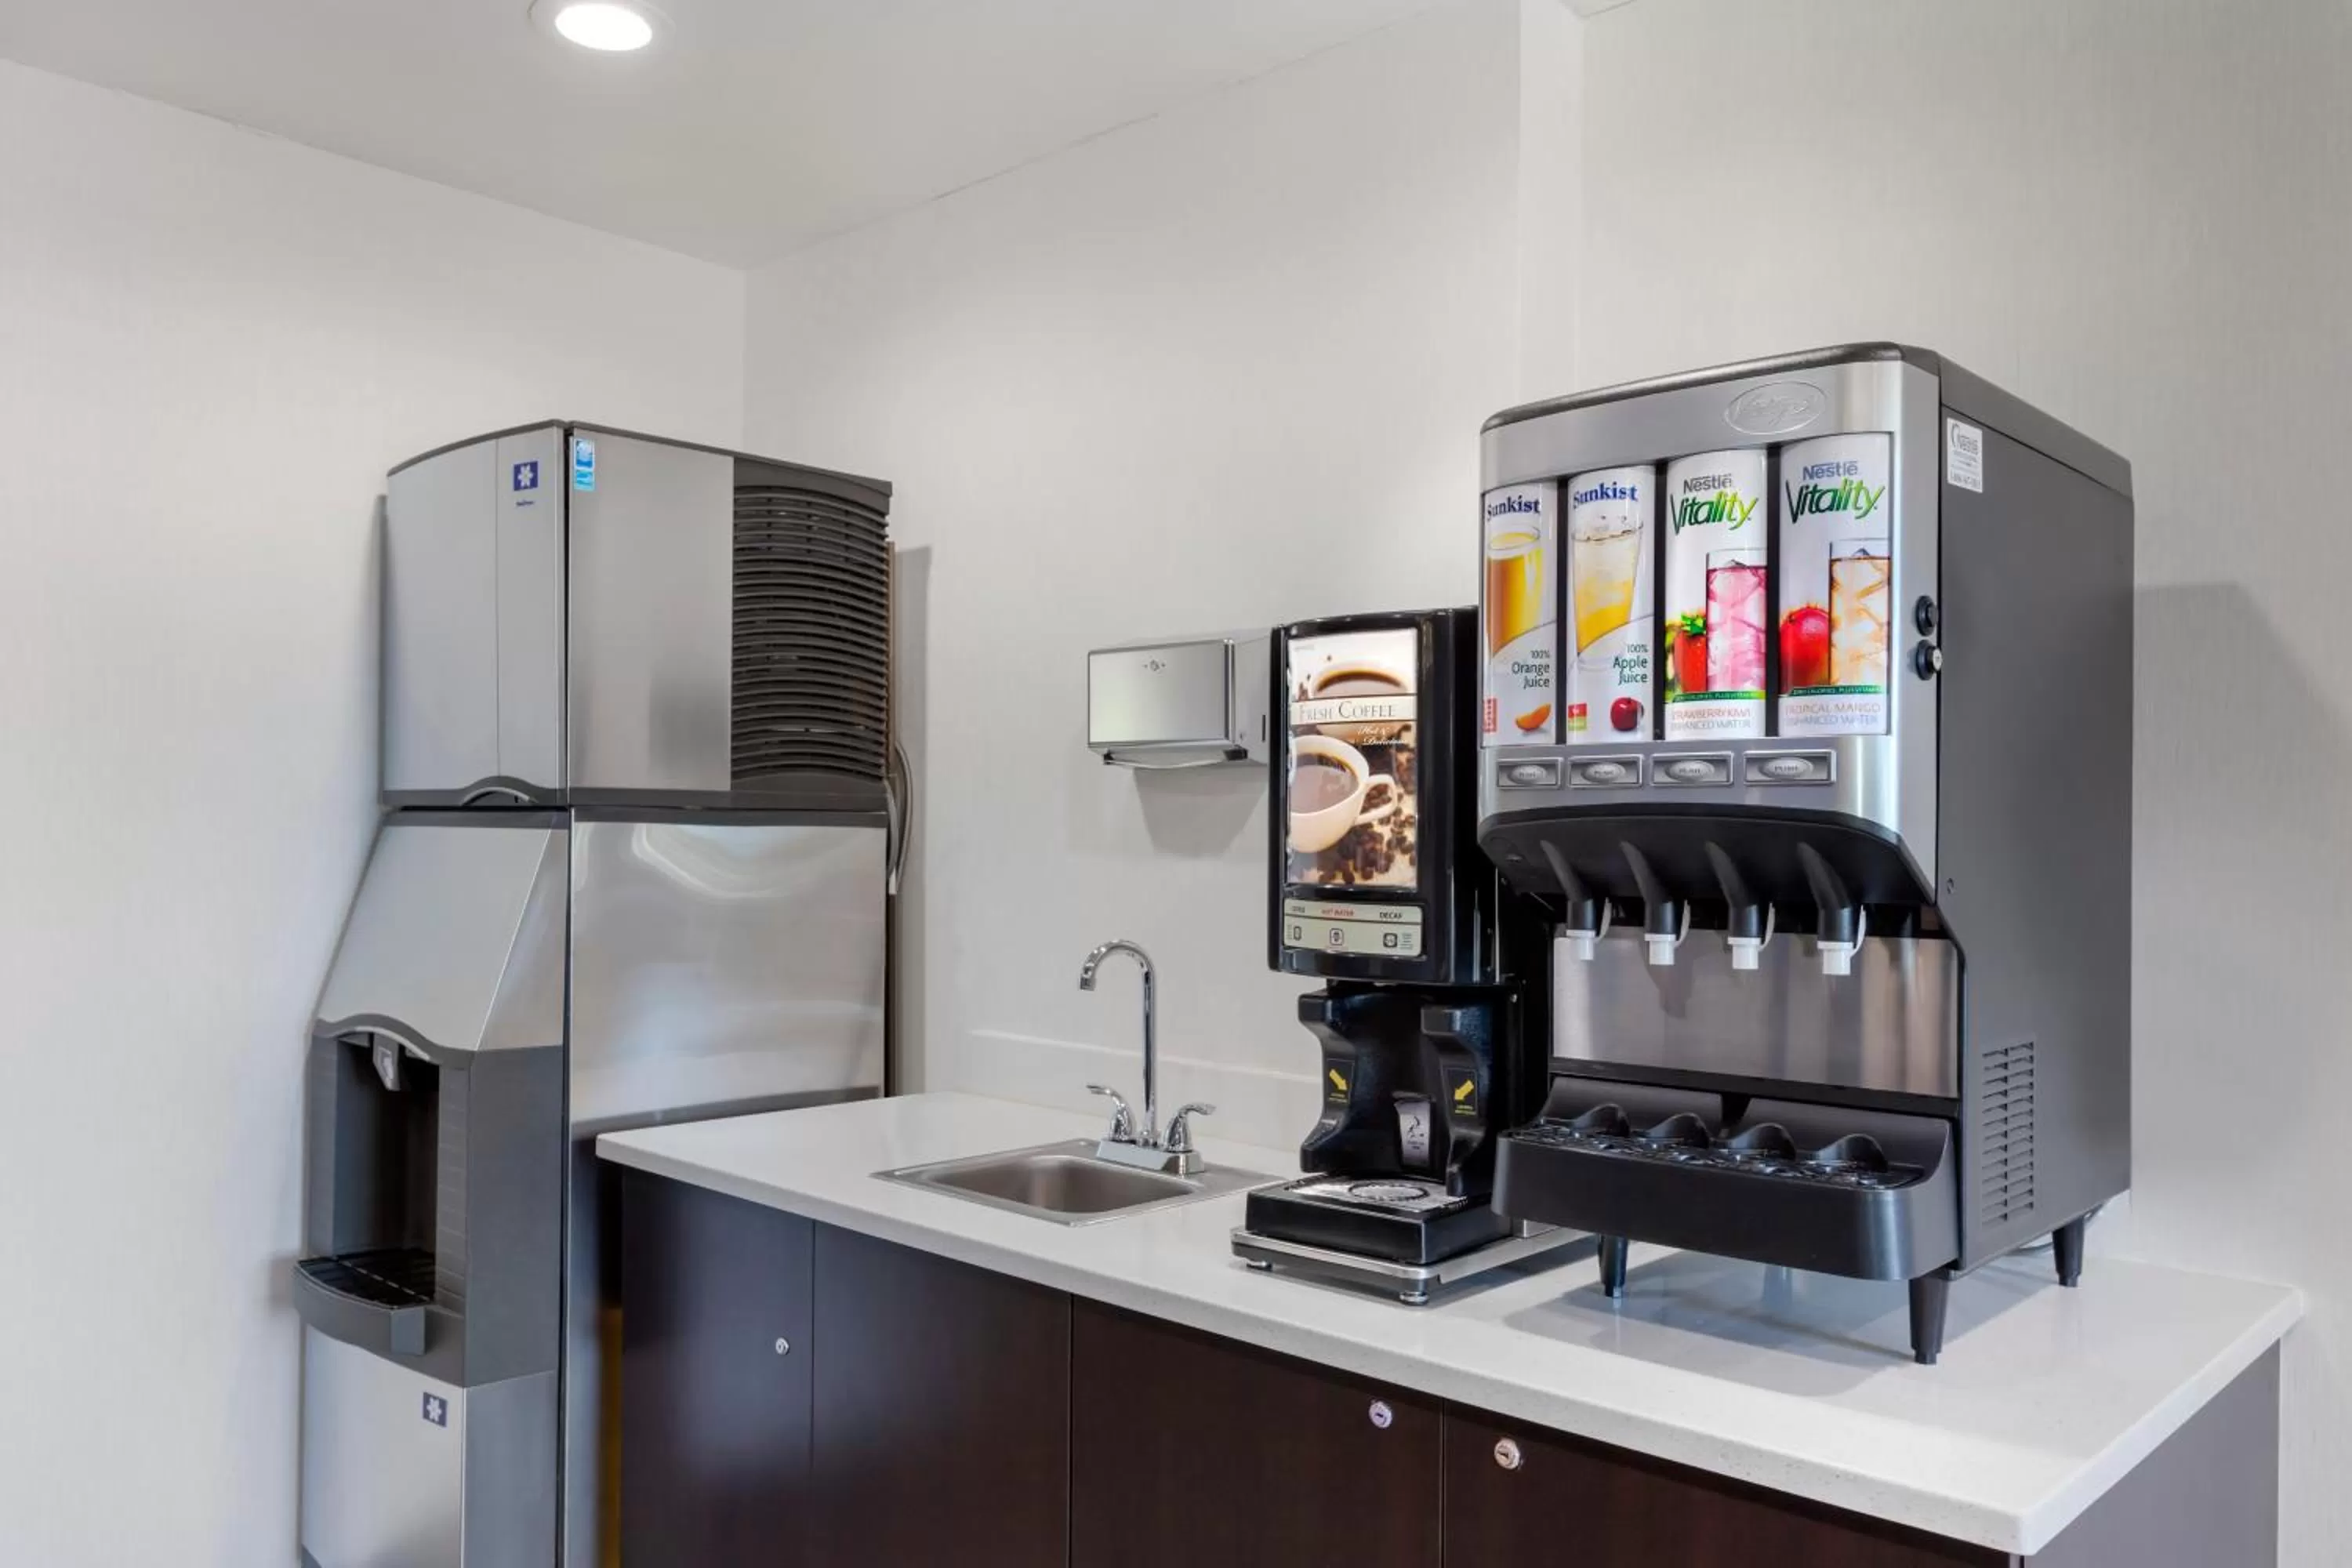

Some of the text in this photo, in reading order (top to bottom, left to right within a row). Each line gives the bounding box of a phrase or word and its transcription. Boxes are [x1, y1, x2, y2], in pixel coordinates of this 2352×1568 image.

[1573, 481, 1639, 510] Sunkist
[1785, 477, 1886, 524] Vitality
[1486, 494, 1541, 521] Sunkist
[1669, 488, 1759, 536] Vitality
[1530, 650, 1551, 659] 100%
[1626, 644, 1649, 653] 100%
[1511, 662, 1551, 676] Orange
[1612, 655, 1648, 671] Apple
[1523, 675, 1550, 689] Juice
[1617, 670, 1648, 685] Juice
[1338, 701, 1396, 719] COFFEE
[1835, 702, 1881, 713] MANGO
